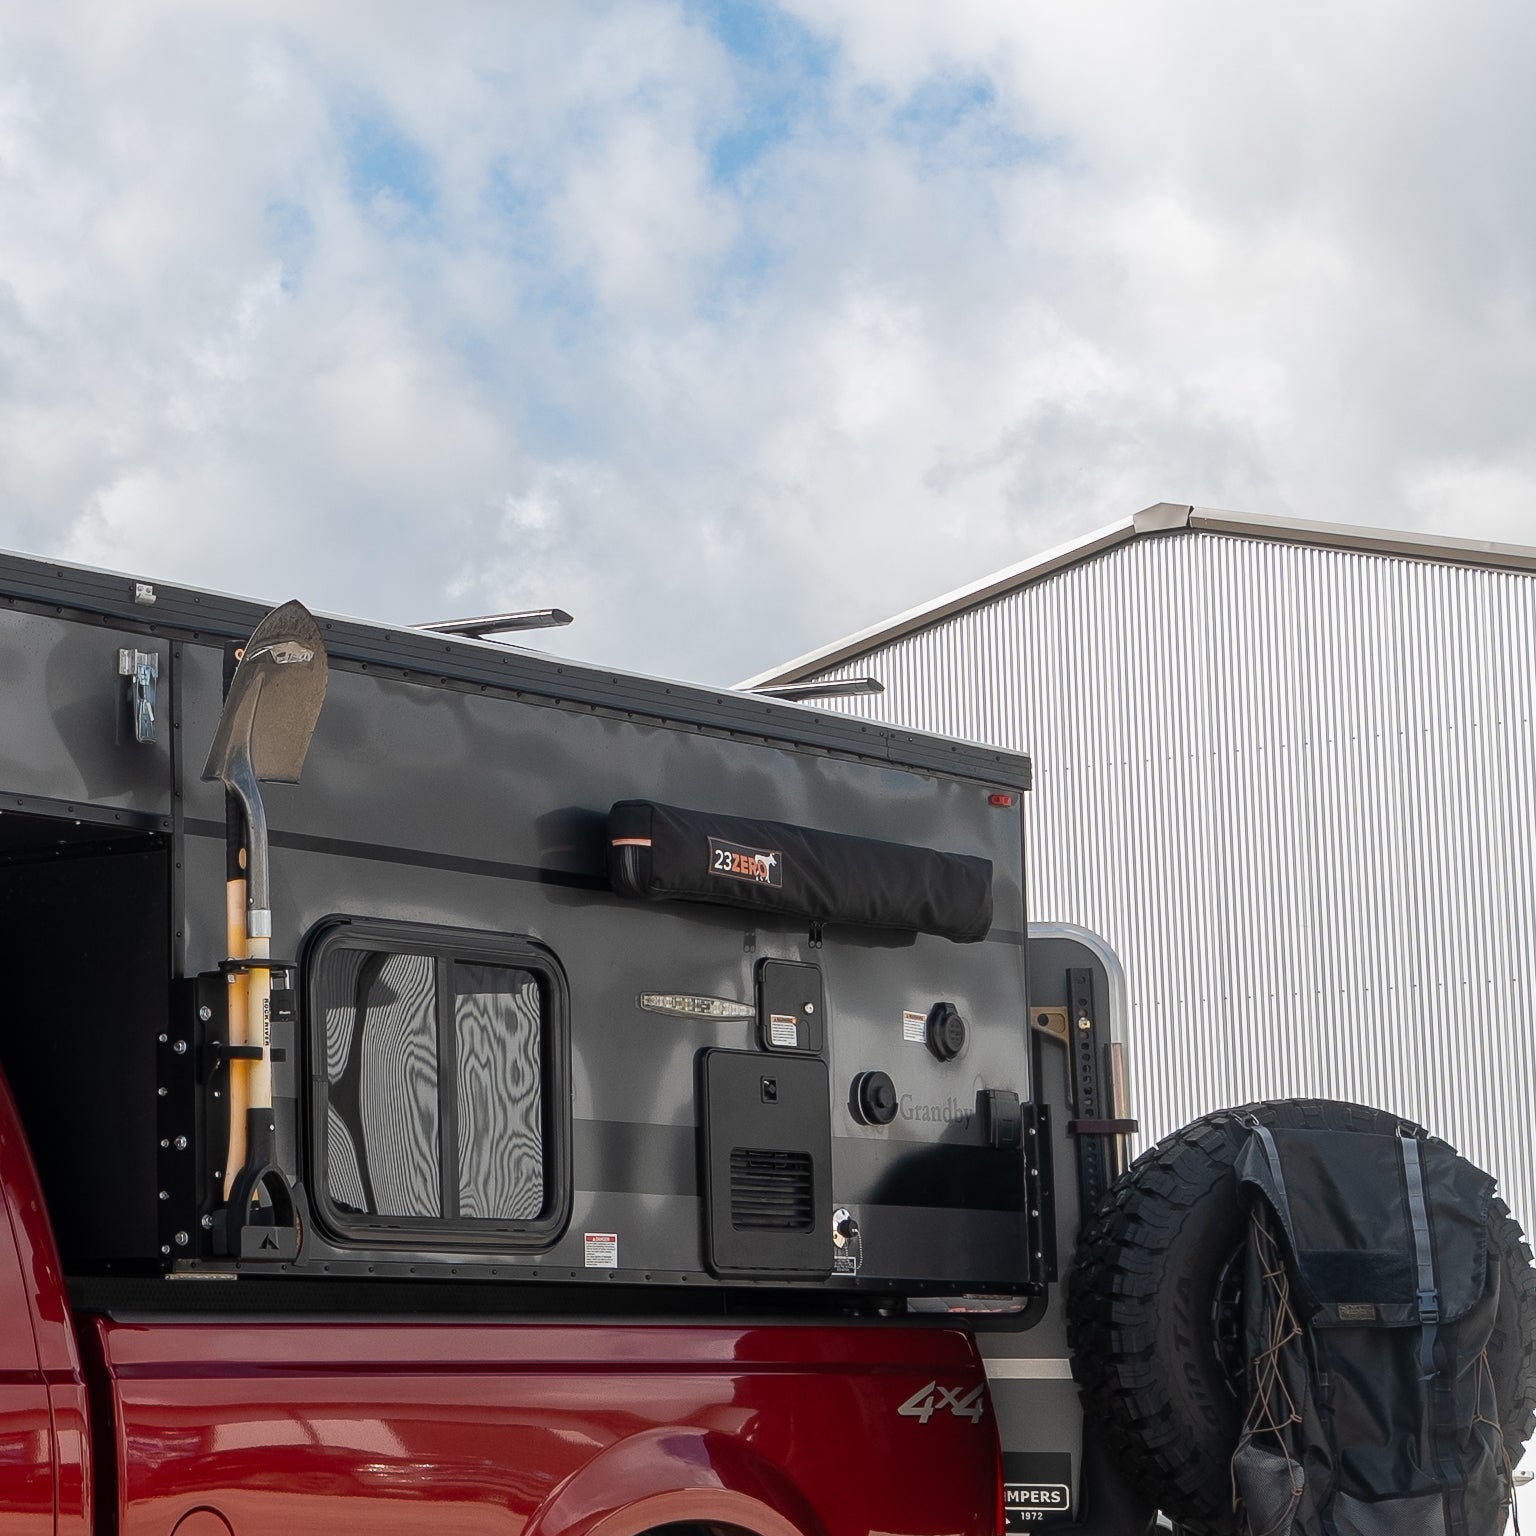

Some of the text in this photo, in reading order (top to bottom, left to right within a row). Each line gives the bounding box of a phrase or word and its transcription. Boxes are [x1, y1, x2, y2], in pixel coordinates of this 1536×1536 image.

[714, 849, 768, 878] 23ZERO
[1005, 1490, 1061, 1503] MPERS
[1020, 1512, 1043, 1521] 1972
